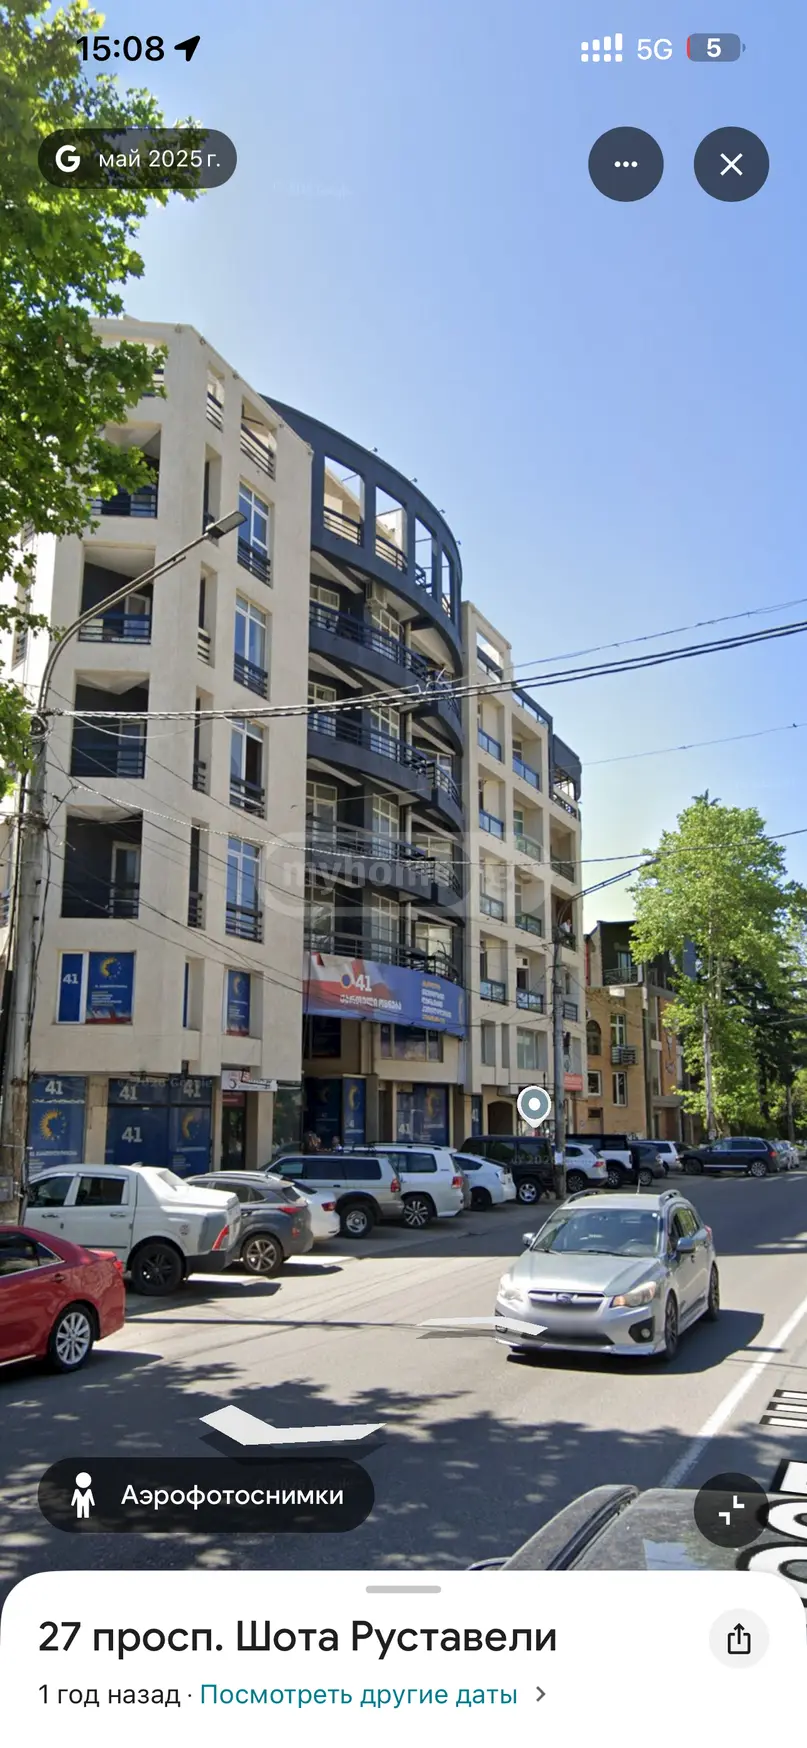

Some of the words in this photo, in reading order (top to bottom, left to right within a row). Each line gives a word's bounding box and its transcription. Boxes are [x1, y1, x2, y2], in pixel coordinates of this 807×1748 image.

[63, 973, 78, 985] 41
[355, 974, 372, 992] 41
[45, 1080, 63, 1095] 41
[119, 1085, 138, 1101] 41
[183, 1081, 201, 1098] 41
[121, 1127, 142, 1143] 41
